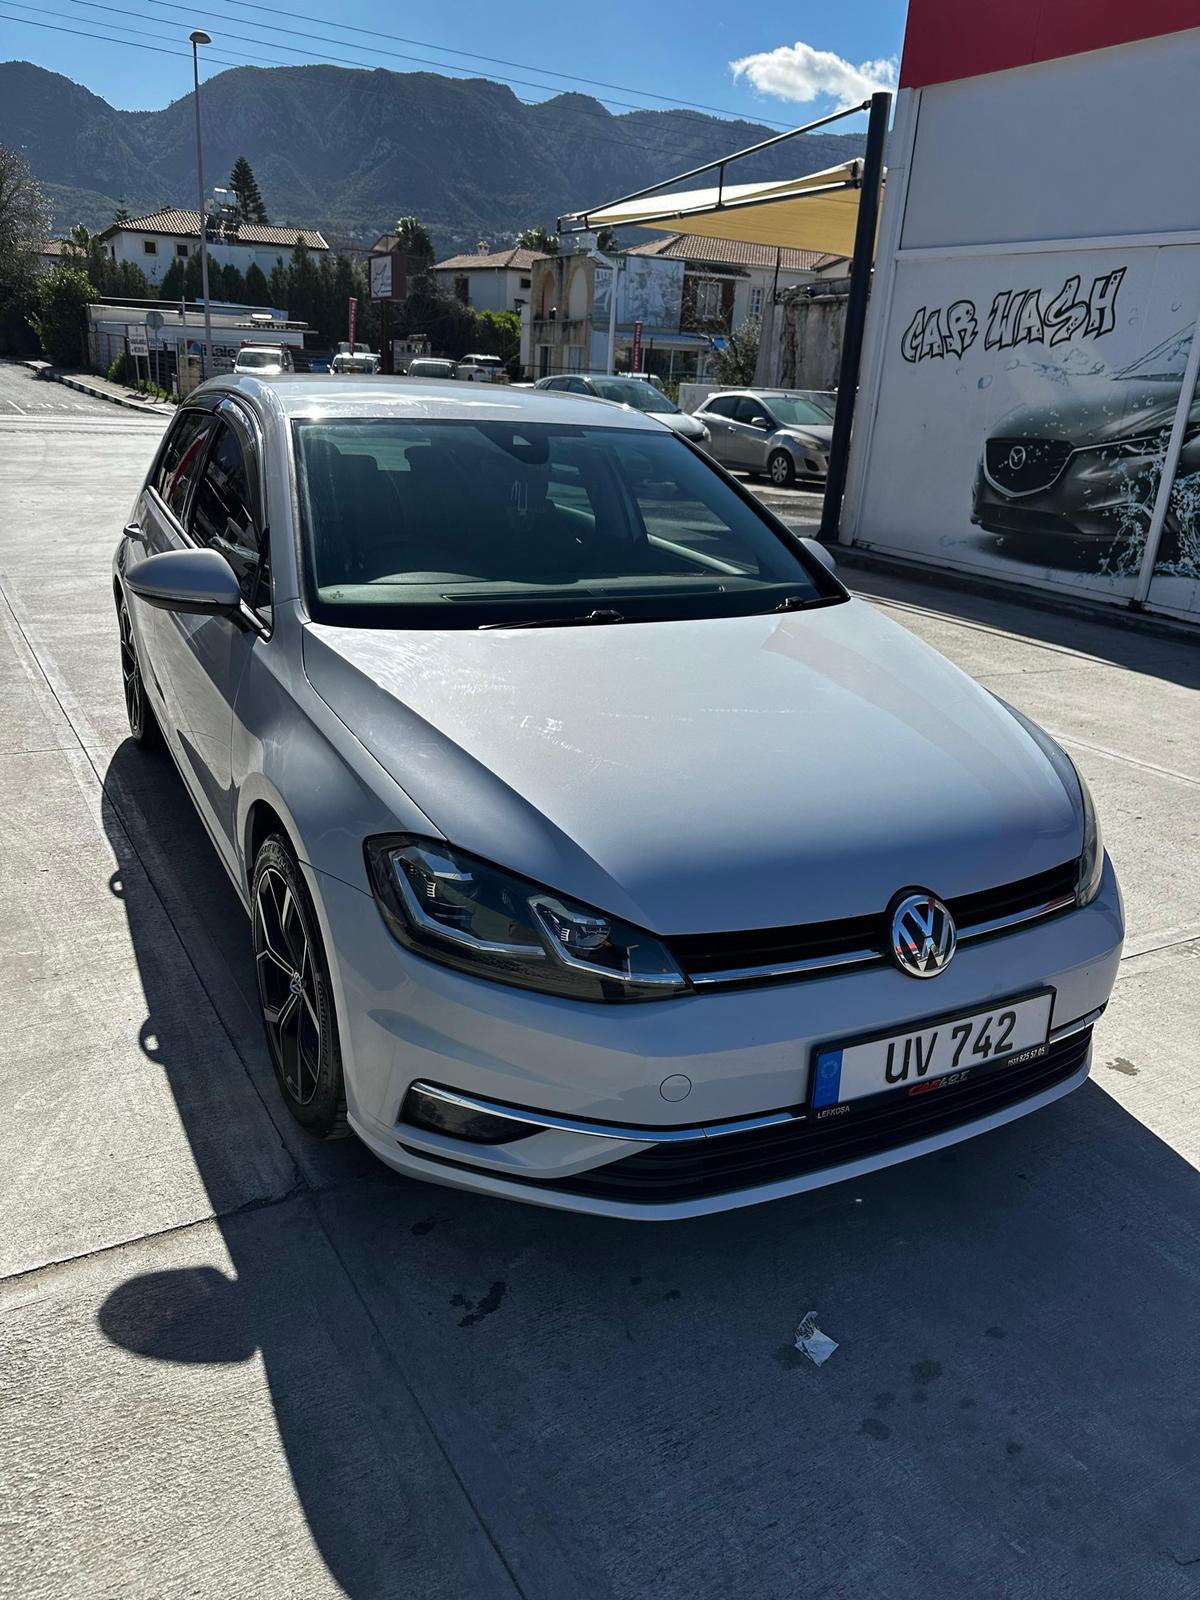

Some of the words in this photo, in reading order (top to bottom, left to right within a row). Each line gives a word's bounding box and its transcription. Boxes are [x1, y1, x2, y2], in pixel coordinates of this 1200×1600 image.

[900, 300, 978, 363] CAR
[984, 266, 1127, 351] WASH
[885, 1031, 939, 1083] UV
[951, 1011, 1017, 1067] 742
